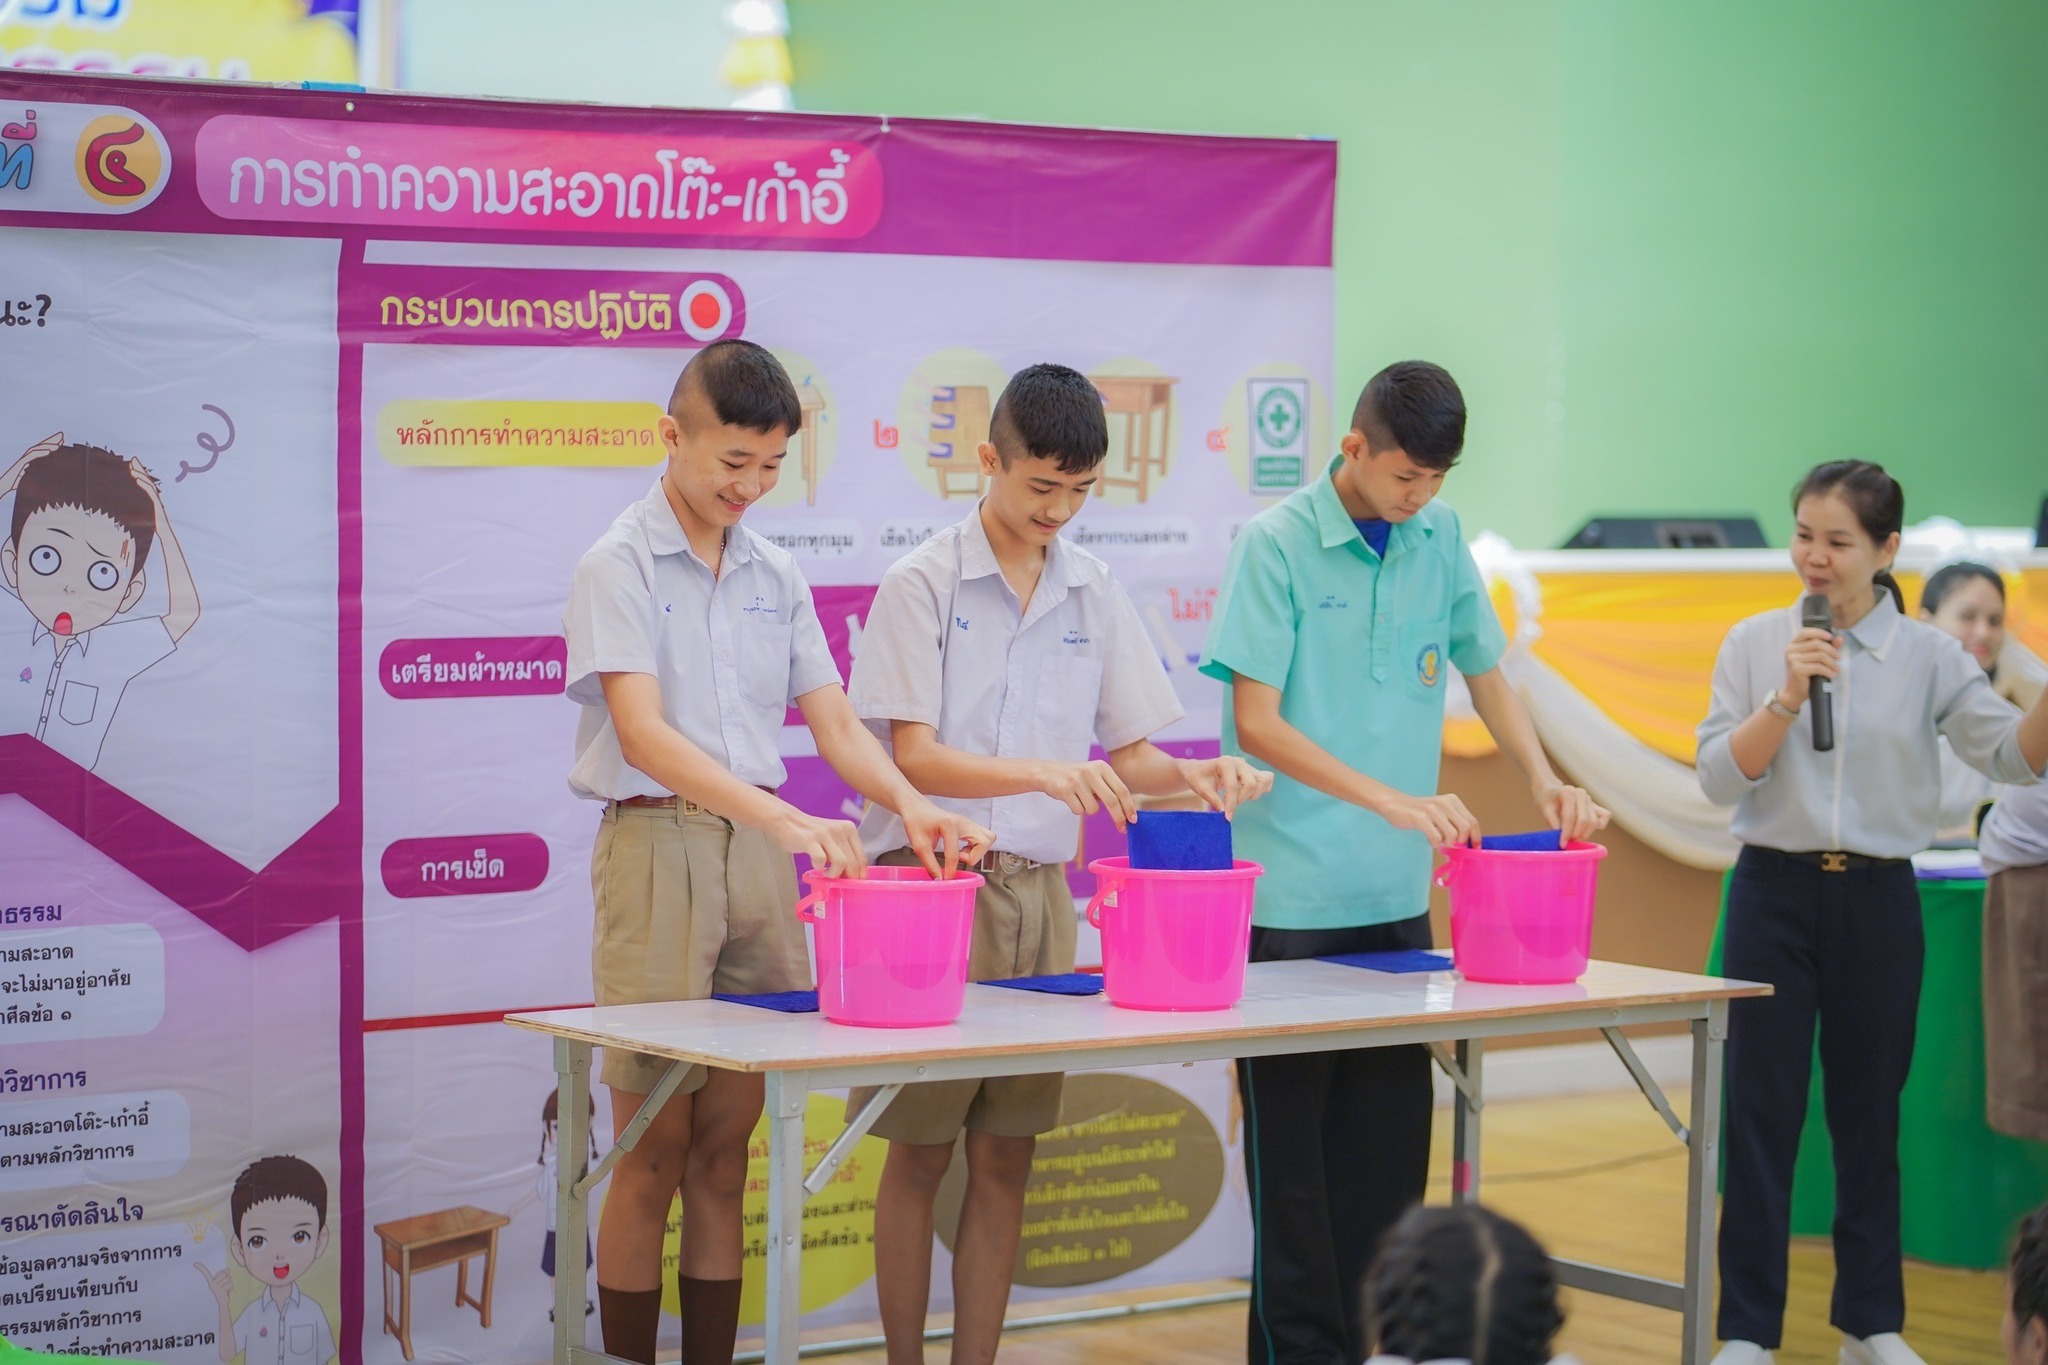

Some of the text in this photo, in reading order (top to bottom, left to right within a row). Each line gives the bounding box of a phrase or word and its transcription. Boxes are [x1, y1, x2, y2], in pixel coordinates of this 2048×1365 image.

[85, 122, 147, 197] ๔
[229, 145, 851, 225] การทำความสะอาดโต๊ะ-เก้าอี้
[381, 289, 672, 341] กระบวนการปฏิบัติ
[397, 417, 654, 446] หลักการทำความสะอาด
[392, 651, 562, 683] เตรียมผ้าหมาด
[421, 848, 505, 882] การเช็ด
[0, 904, 62, 924] ธรรม
[1, 968, 131, 996] จะไม่มาอยู่อาศัย
[0, 1068, 87, 1094] วิชาการ
[1, 1143, 135, 1168] ตามหลักวิชาการ
[1, 1197, 144, 1233] รณาตัดสินใจ
[0, 1275, 139, 1306] ตเปรียบเทียบกับ
